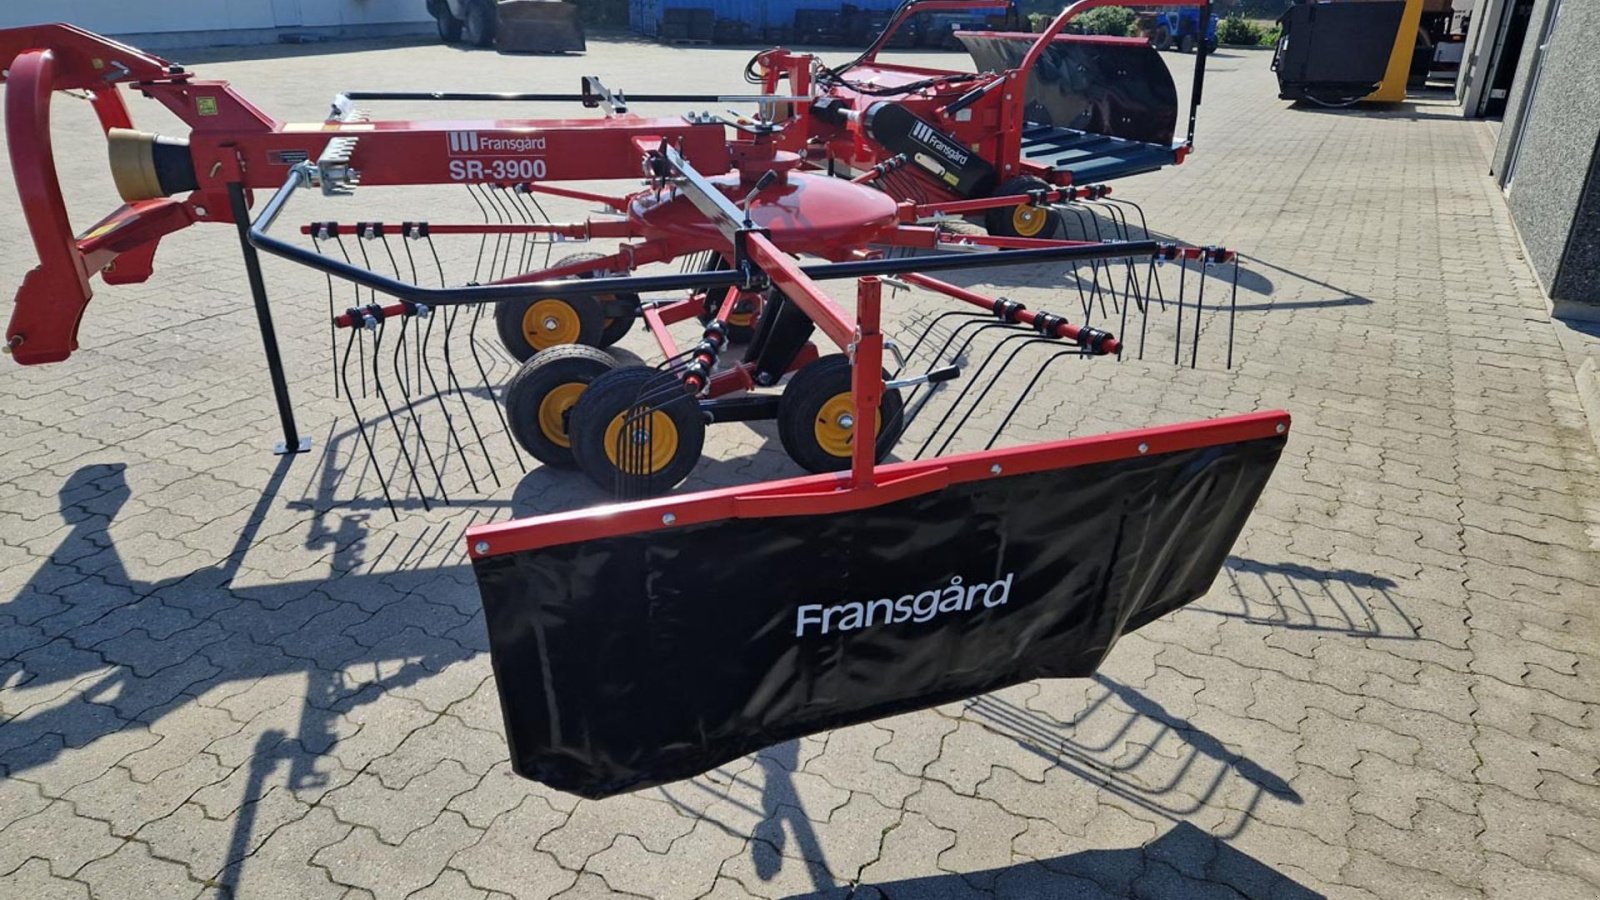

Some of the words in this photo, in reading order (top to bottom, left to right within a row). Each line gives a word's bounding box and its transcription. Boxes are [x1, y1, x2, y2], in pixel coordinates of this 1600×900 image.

[480, 136, 546, 152] Fransgård
[929, 136, 968, 165] Fransgård
[449, 159, 546, 180] SR-3900
[796, 573, 1014, 637] Fransgård
